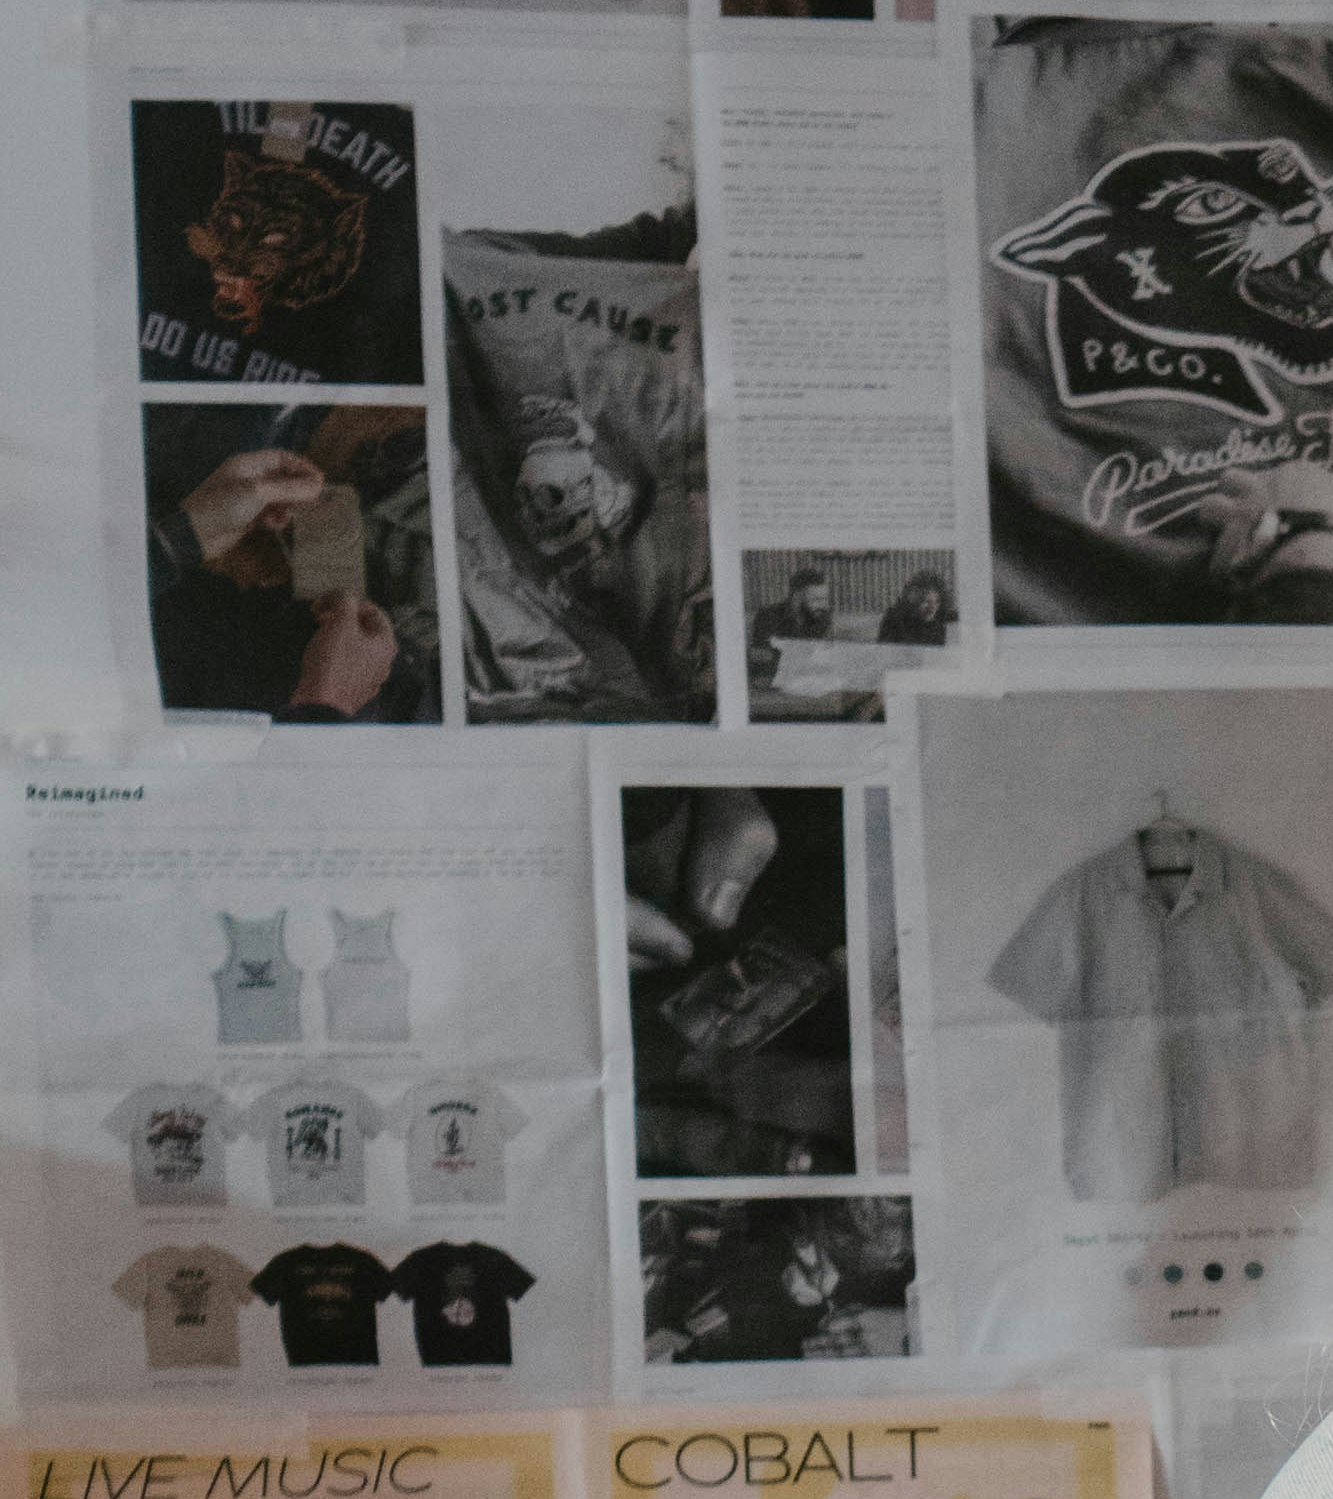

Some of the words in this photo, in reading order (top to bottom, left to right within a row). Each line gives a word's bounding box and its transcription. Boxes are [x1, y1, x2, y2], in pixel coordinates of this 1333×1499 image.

[308, 111, 411, 191] DEATH
[140, 312, 188, 359] DO
[192, 331, 240, 376] US
[466, 286, 537, 325] OST
[553, 290, 680, 354] CAUSE
[1082, 425, 1297, 530] Paradise
[24, 784, 145, 804] Reimagined
[614, 1426, 941, 1492] COBALT
